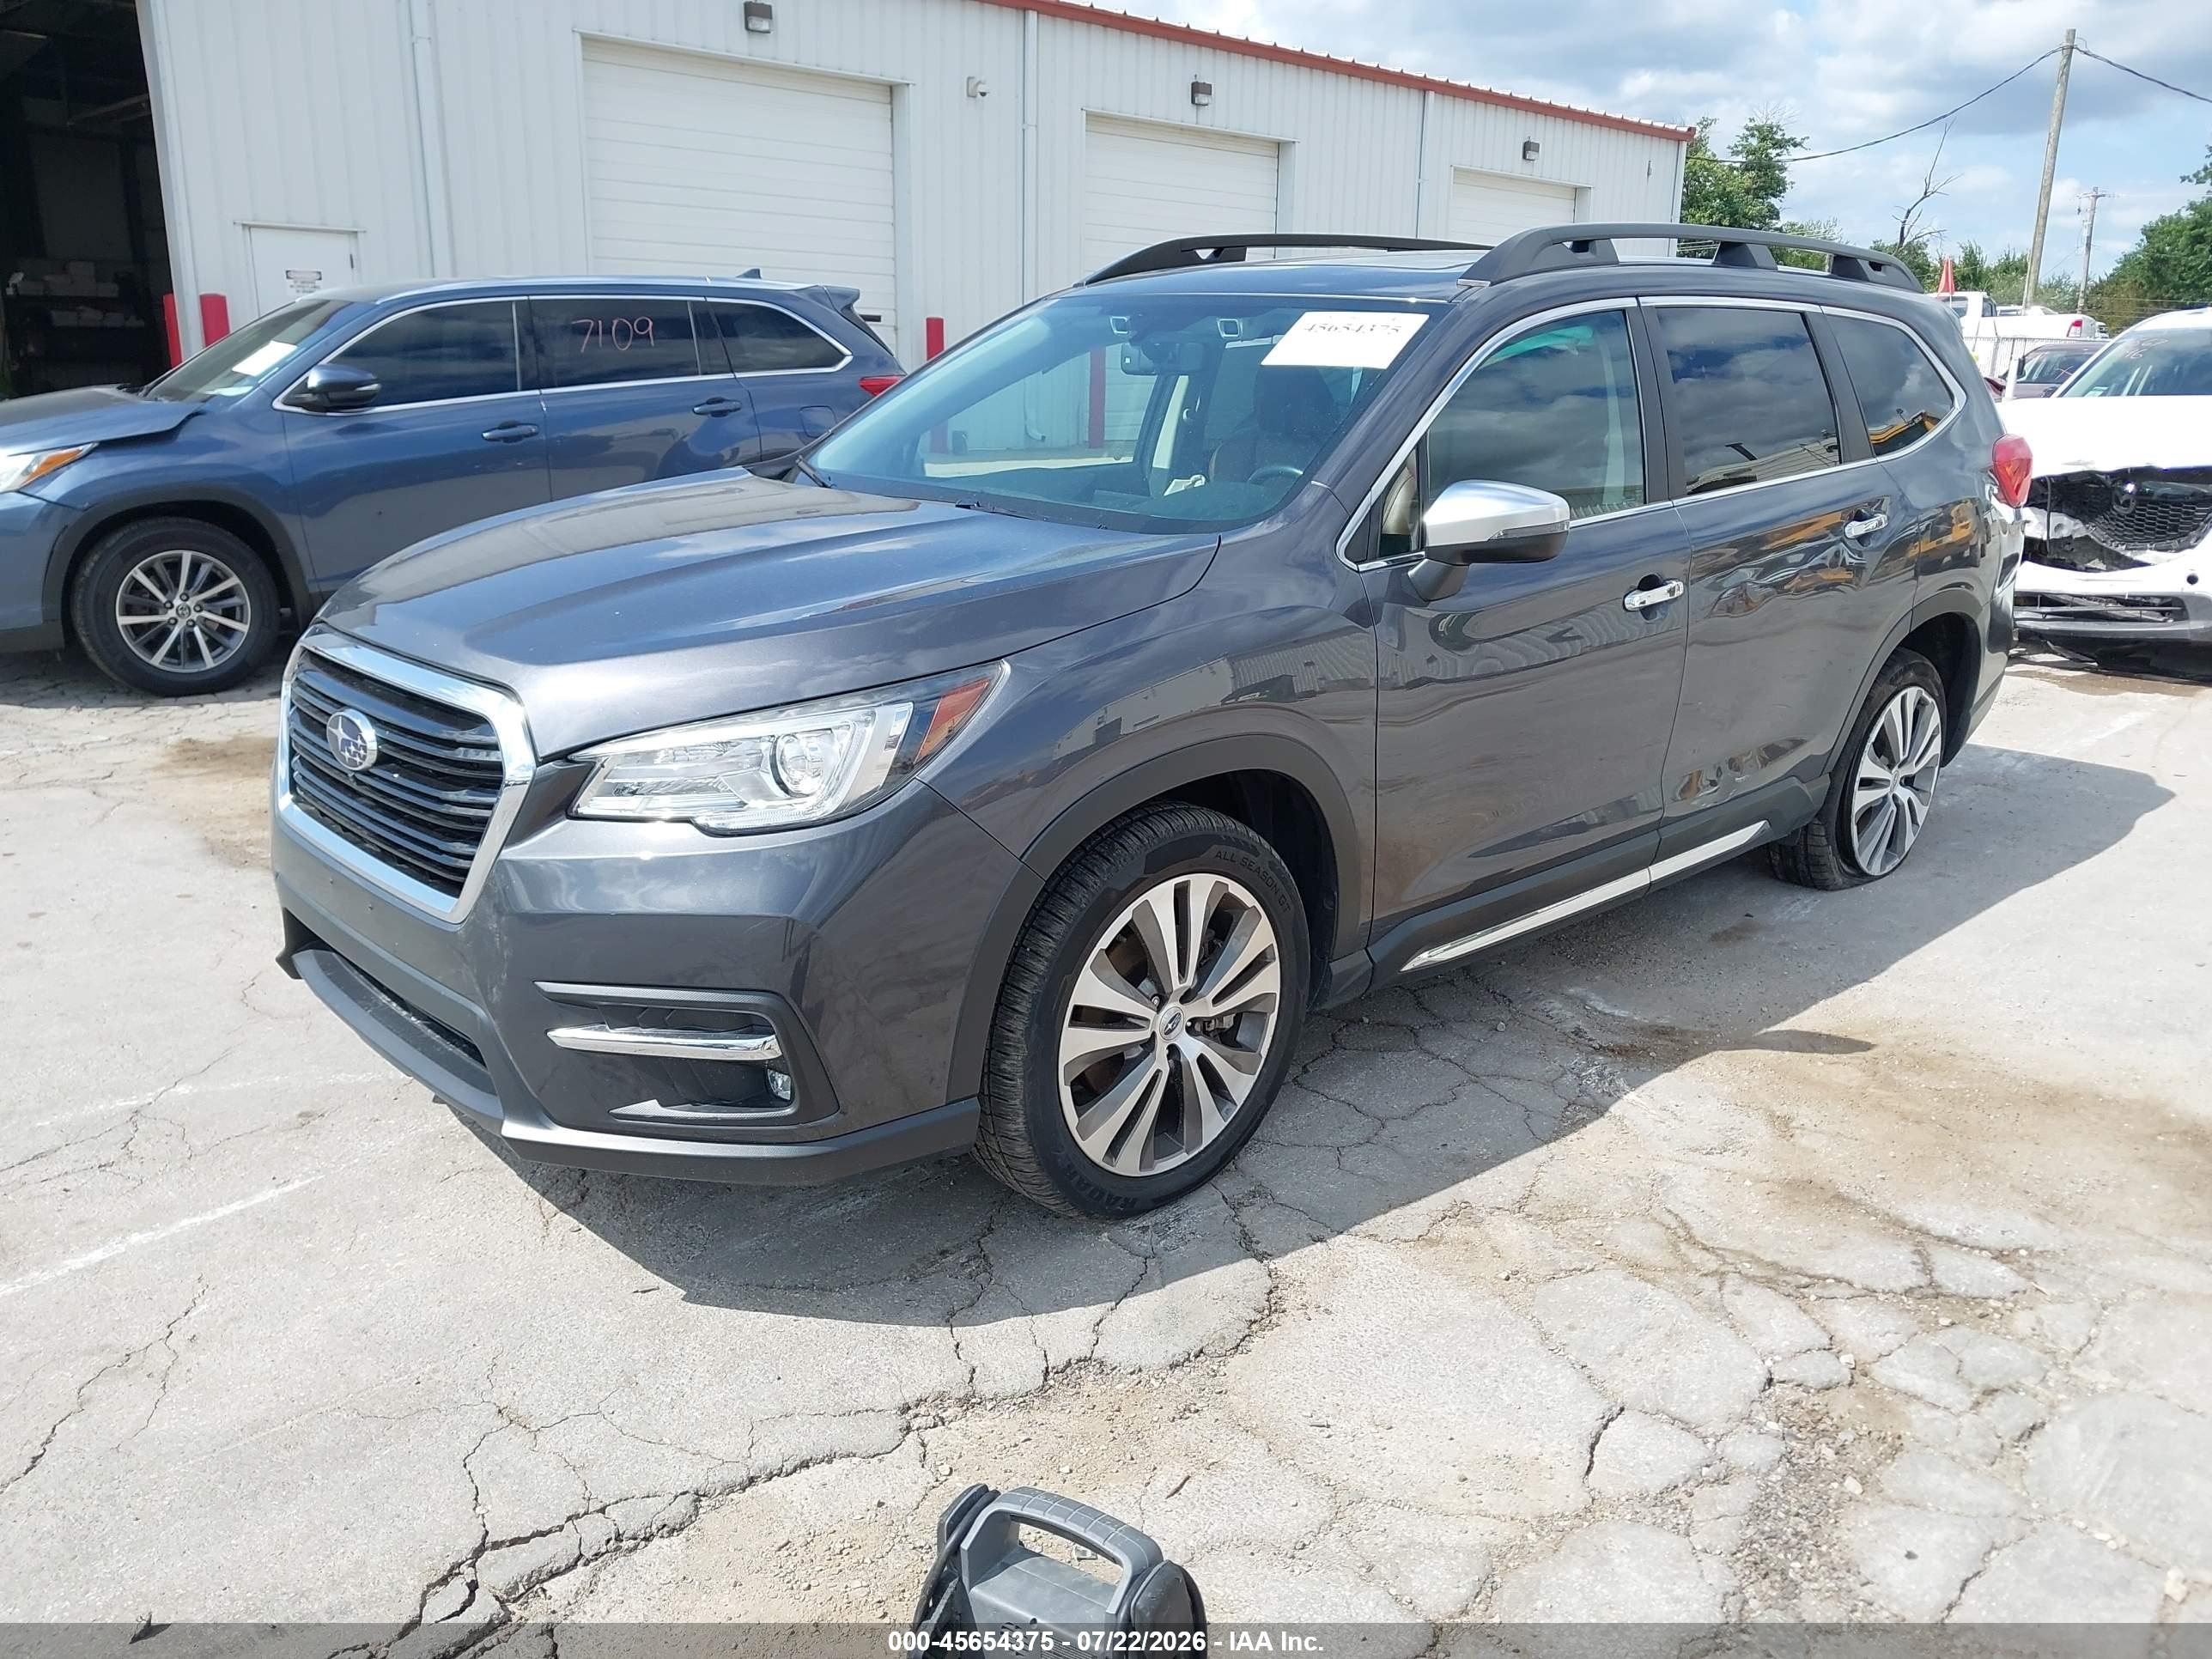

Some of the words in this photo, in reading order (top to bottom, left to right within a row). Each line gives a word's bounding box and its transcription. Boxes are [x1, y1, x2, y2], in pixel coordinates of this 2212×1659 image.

[571, 316, 654, 353] 7109
[1215, 851, 1237, 863] ALL
[1239, 857, 1279, 894] SEASON
[1278, 895, 1291, 912] GT
